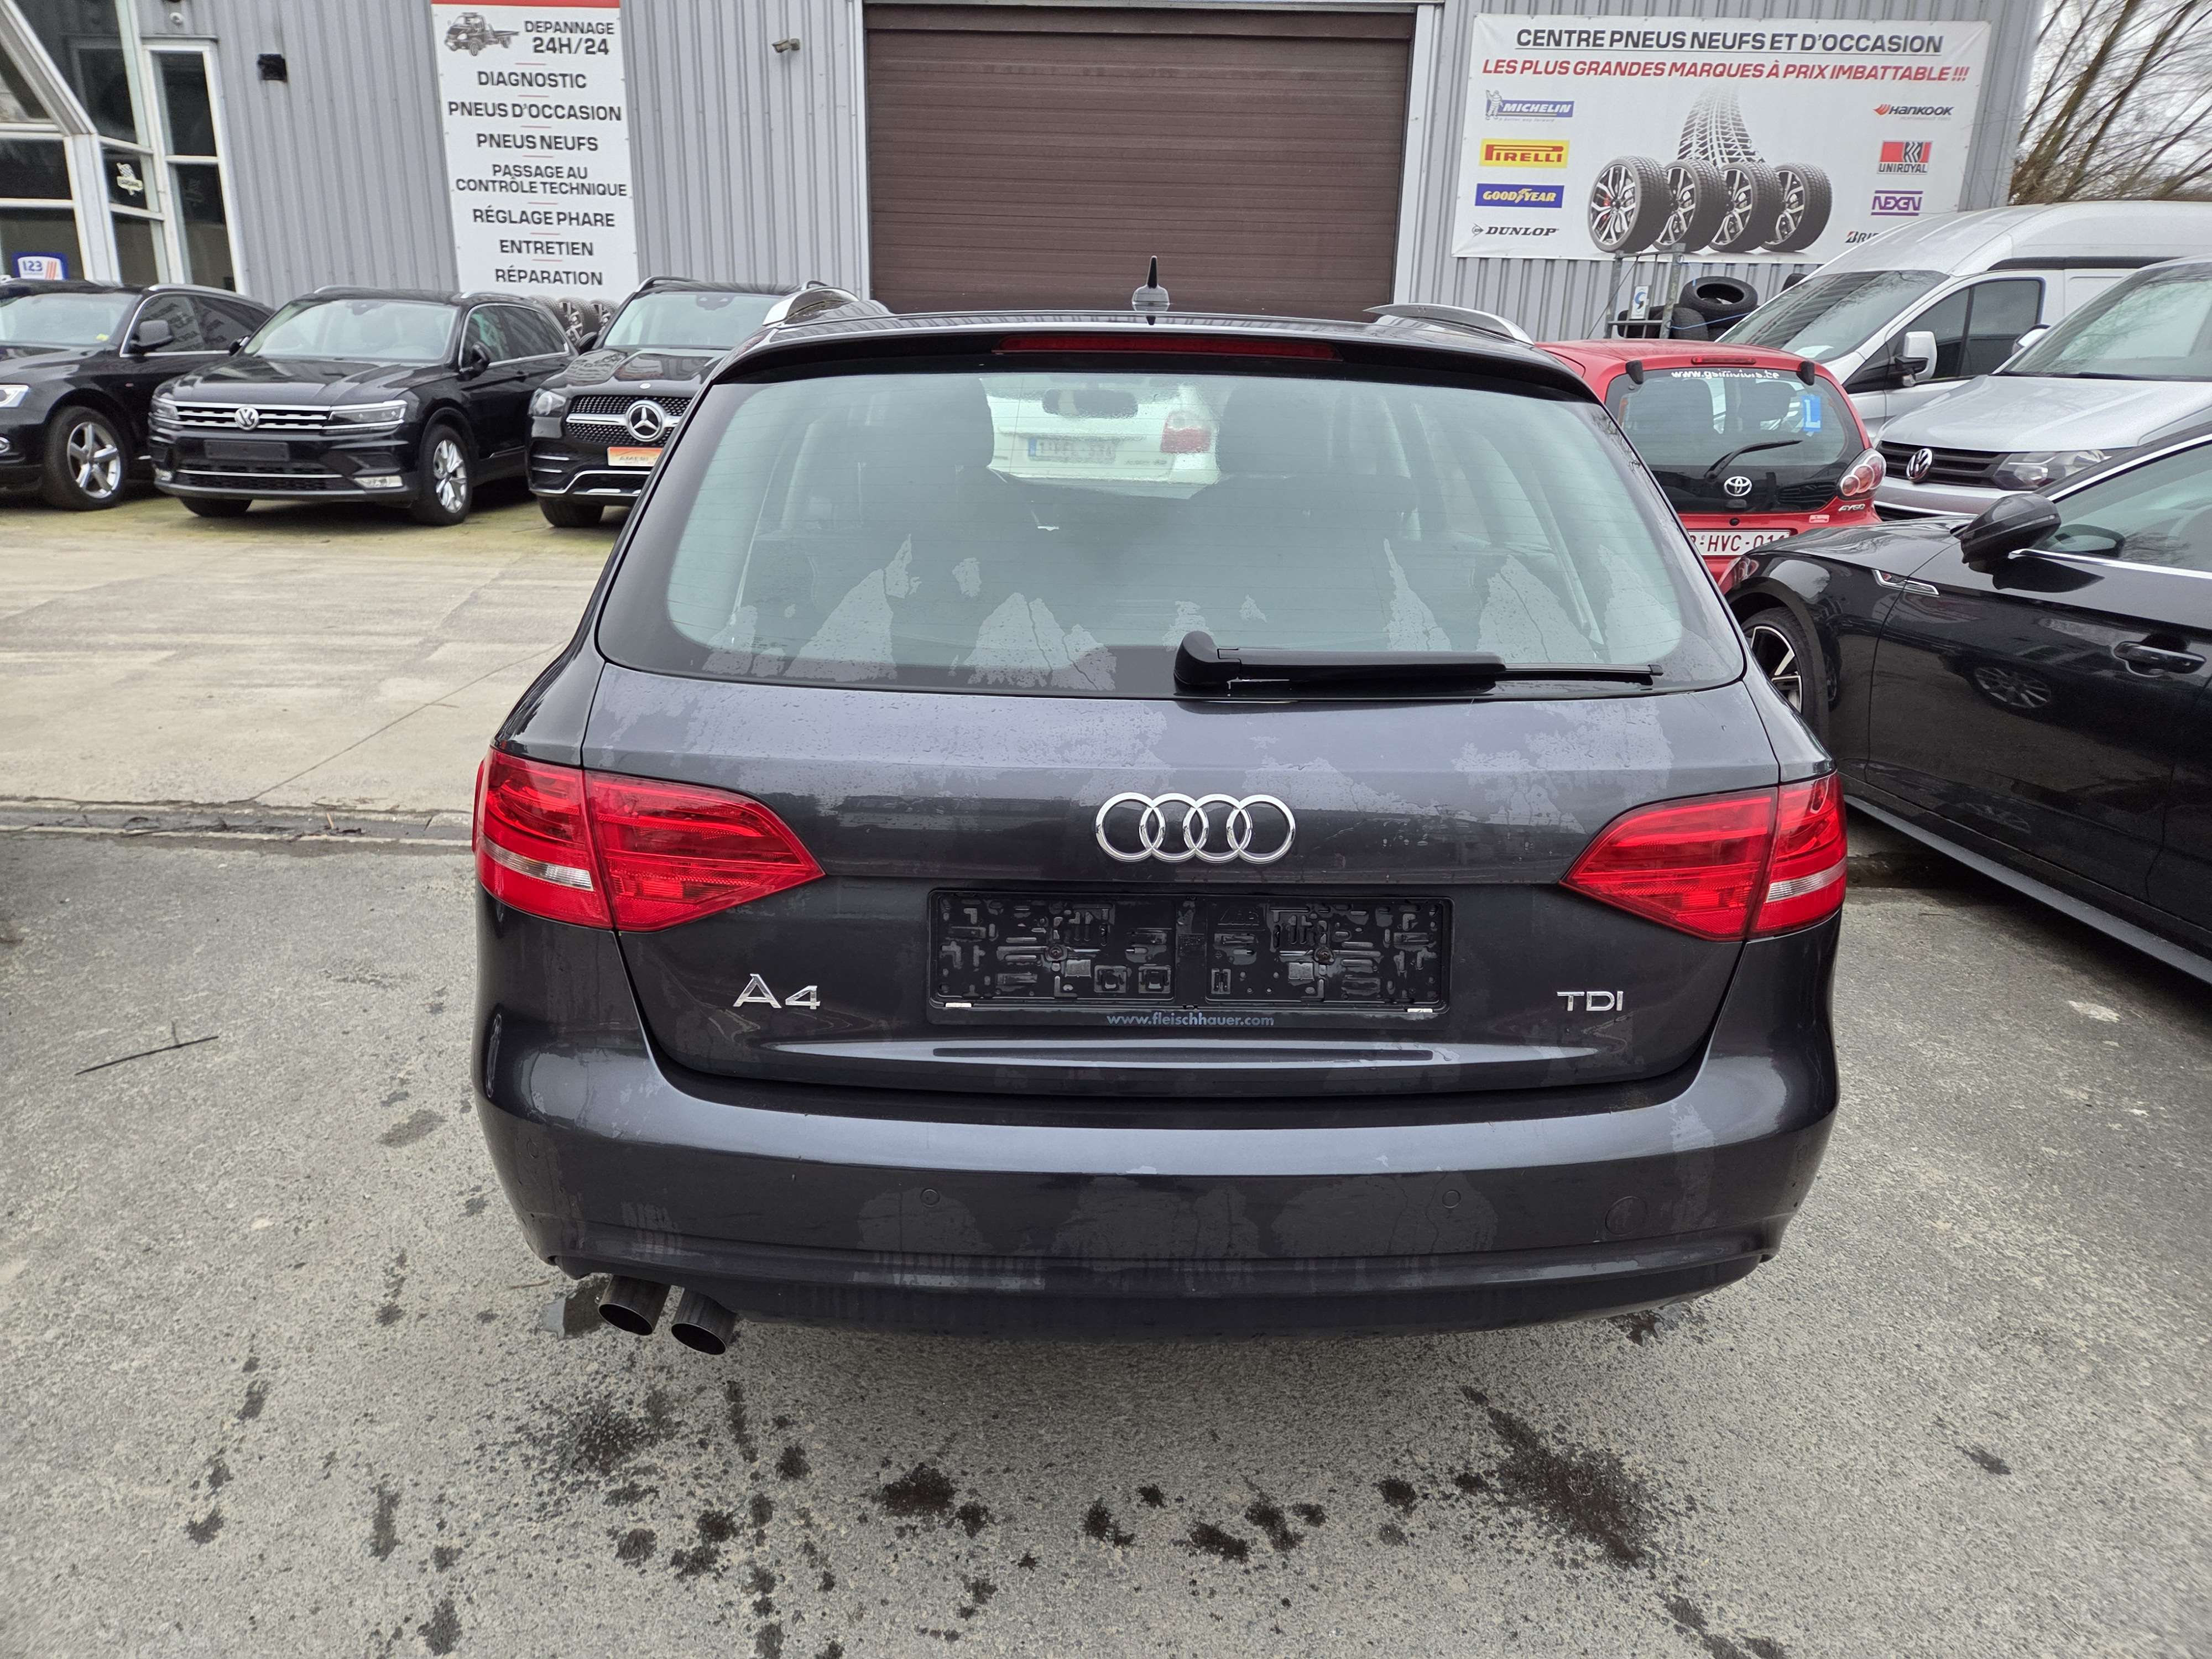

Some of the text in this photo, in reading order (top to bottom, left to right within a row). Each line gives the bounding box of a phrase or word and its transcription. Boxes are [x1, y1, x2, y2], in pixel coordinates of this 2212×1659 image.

[524, 20, 615, 35] DEPANNAGE
[533, 36, 609, 55] 24H/24
[1516, 29, 1944, 53] CENTRE PNEUS NEUFS ET D'OCCASION
[477, 71, 587, 88] DIAGNOSTIC
[1483, 59, 1970, 82] LES PLUS GRANDES MARQUES À PRIX IMBATTABLE !!!
[448, 101, 622, 121] PNEUS D'OCCASION
[1503, 103, 1572, 113] MICHELIN
[476, 133, 598, 152] PNEUS NEUFS
[1485, 144, 1564, 162] PIRELLI
[492, 164, 588, 179] PASSAGE AU
[1879, 164, 1928, 173] UNIROYAL
[456, 177, 628, 197] CONTRÔLE TECHNIQUE
[1872, 196, 1922, 211] NEXEN
[473, 205, 615, 227] RÉGLAGE PHARE
[1485, 227, 1557, 236] DUNLOP
[1845, 231, 1879, 243] BRI
[499, 239, 594, 257] ENTRETIEN
[22, 260, 43, 272] 123
[495, 265, 603, 286] RÉPARATION
[1804, 399, 1821, 429] L
[733, 973, 821, 1010] A4
[1557, 991, 1624, 1011] TDI
[1107, 1012, 1274, 1026] www.fleischhauer.com
